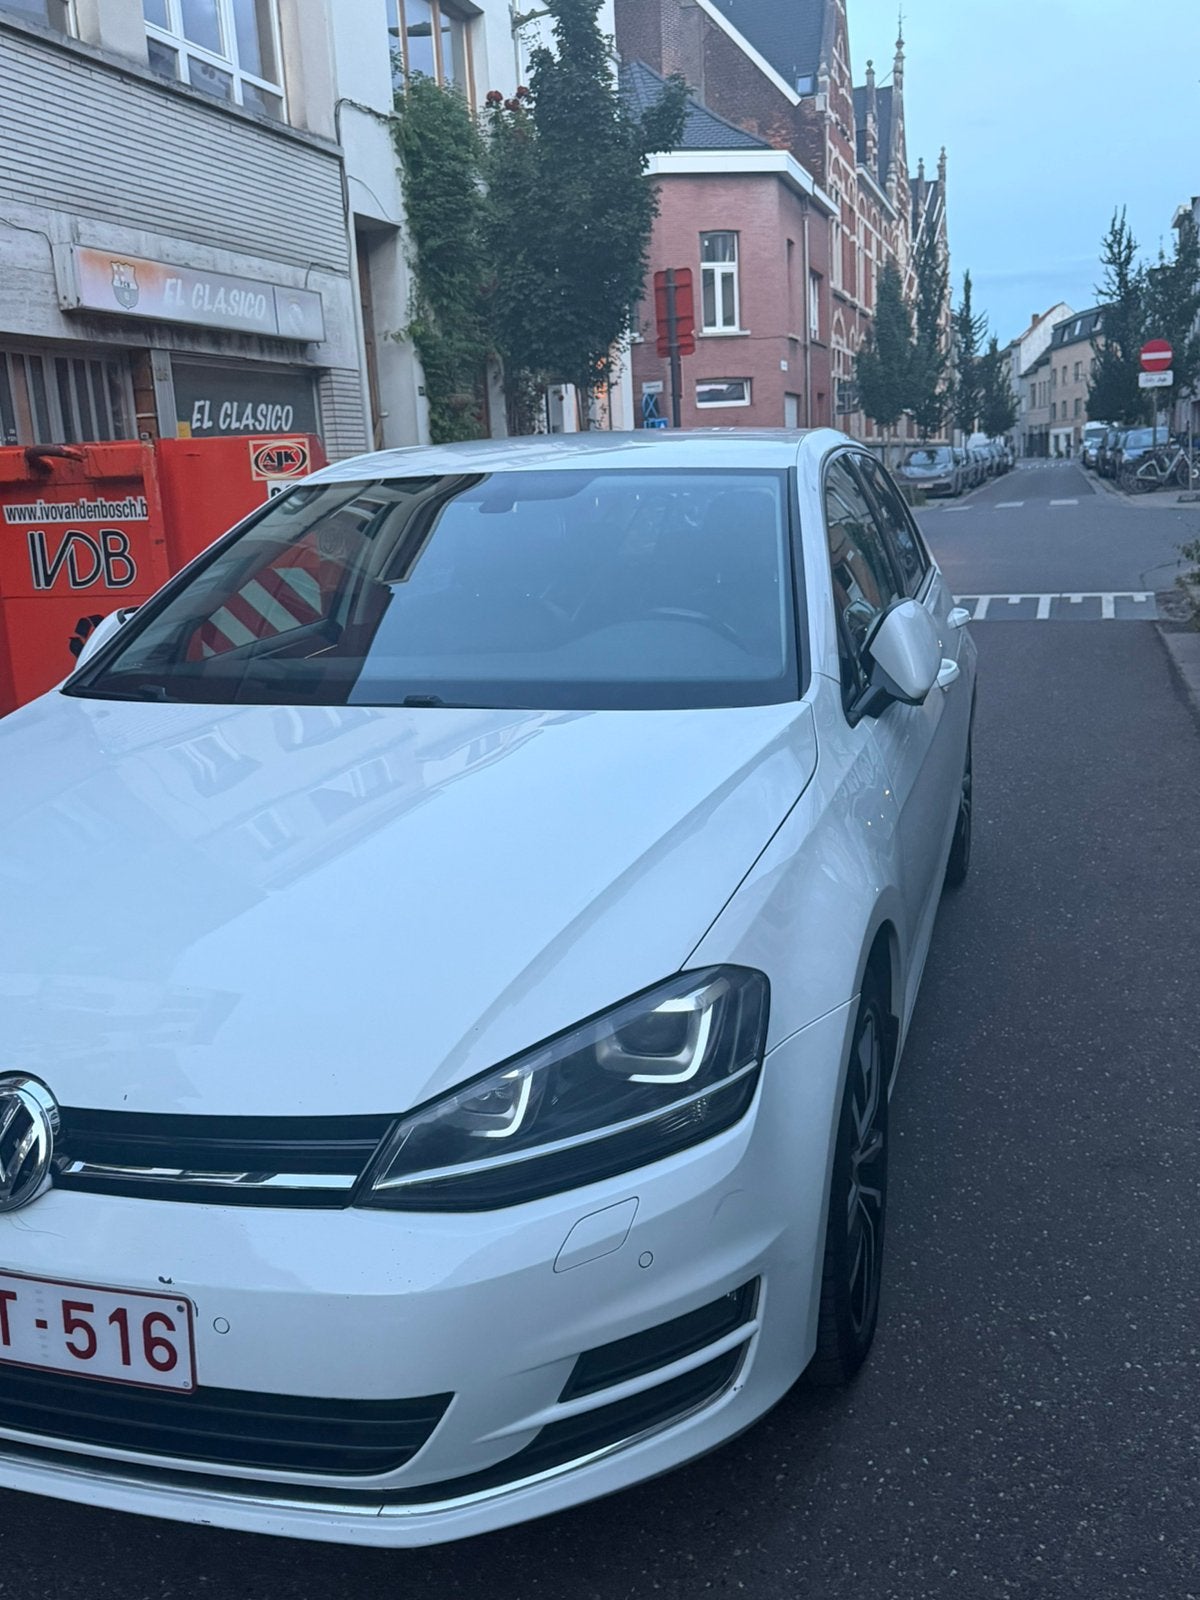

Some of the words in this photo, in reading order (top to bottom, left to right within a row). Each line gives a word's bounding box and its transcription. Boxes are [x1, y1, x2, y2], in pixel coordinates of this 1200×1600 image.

[163, 278, 185, 306] EL
[192, 282, 266, 319] CLASICO
[192, 400, 213, 429] EL
[219, 401, 293, 431] CLASICO
[262, 450, 298, 469] AJK
[0, 1289, 178, 1372] T-516
